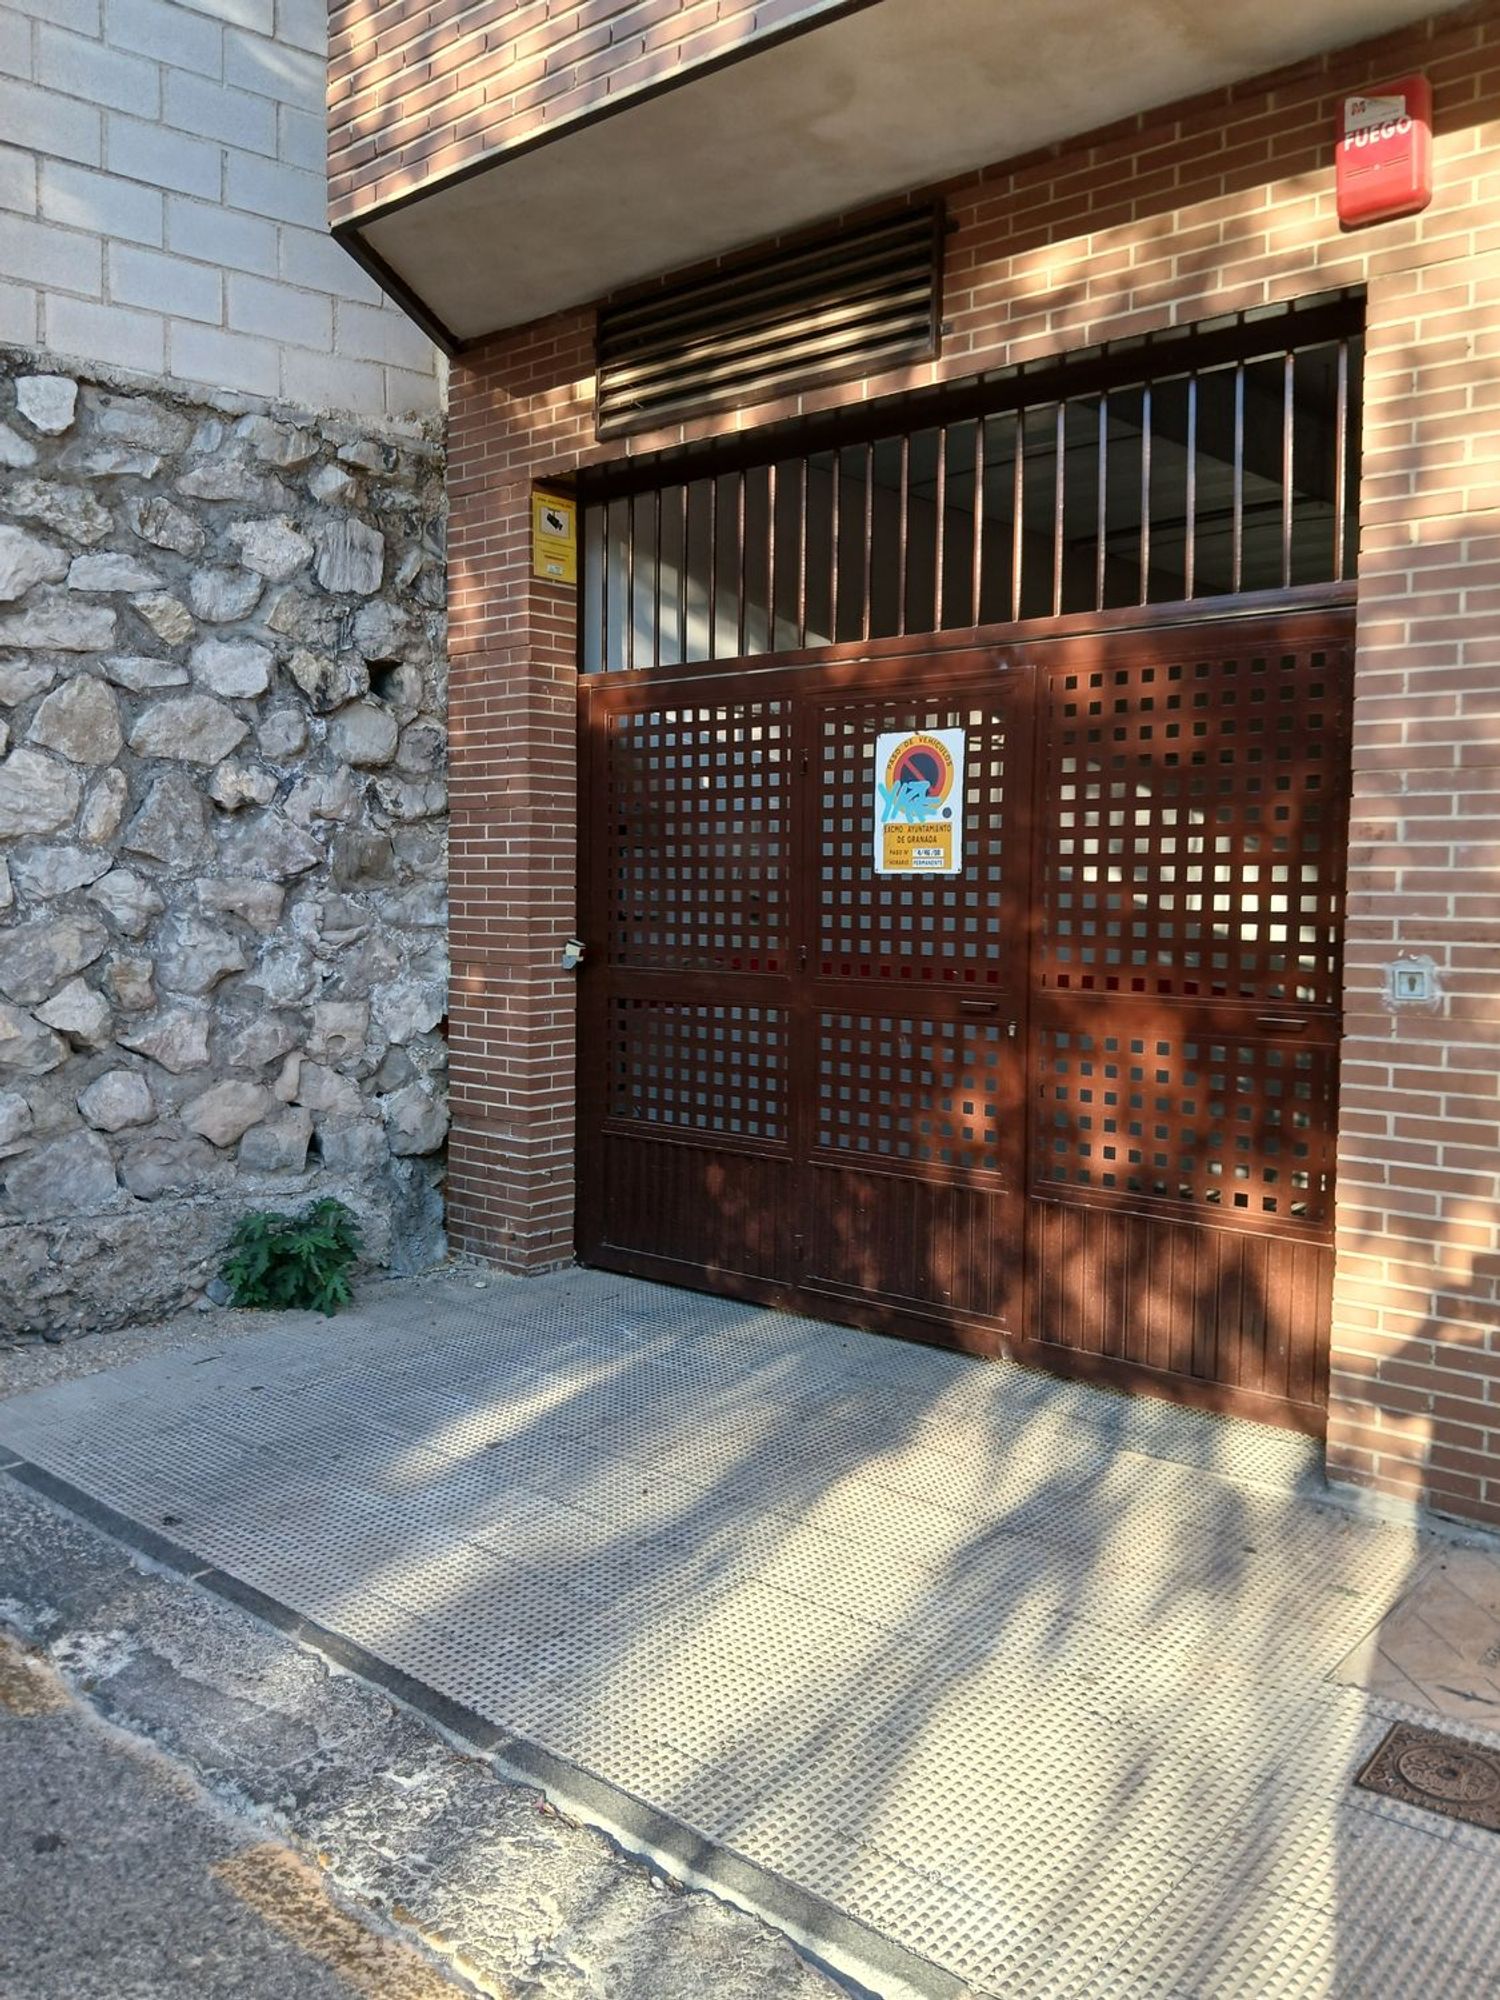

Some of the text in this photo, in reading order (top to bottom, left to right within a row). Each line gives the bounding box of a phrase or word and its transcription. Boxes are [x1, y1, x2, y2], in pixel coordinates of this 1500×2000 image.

[1344, 116, 1412, 152] FUEGO
[887, 748, 901, 769] PASO
[904, 738, 914, 748] DE
[908, 824, 952, 833] AYUNTAMIENTO
[897, 835, 937, 844] DE GRANADA
